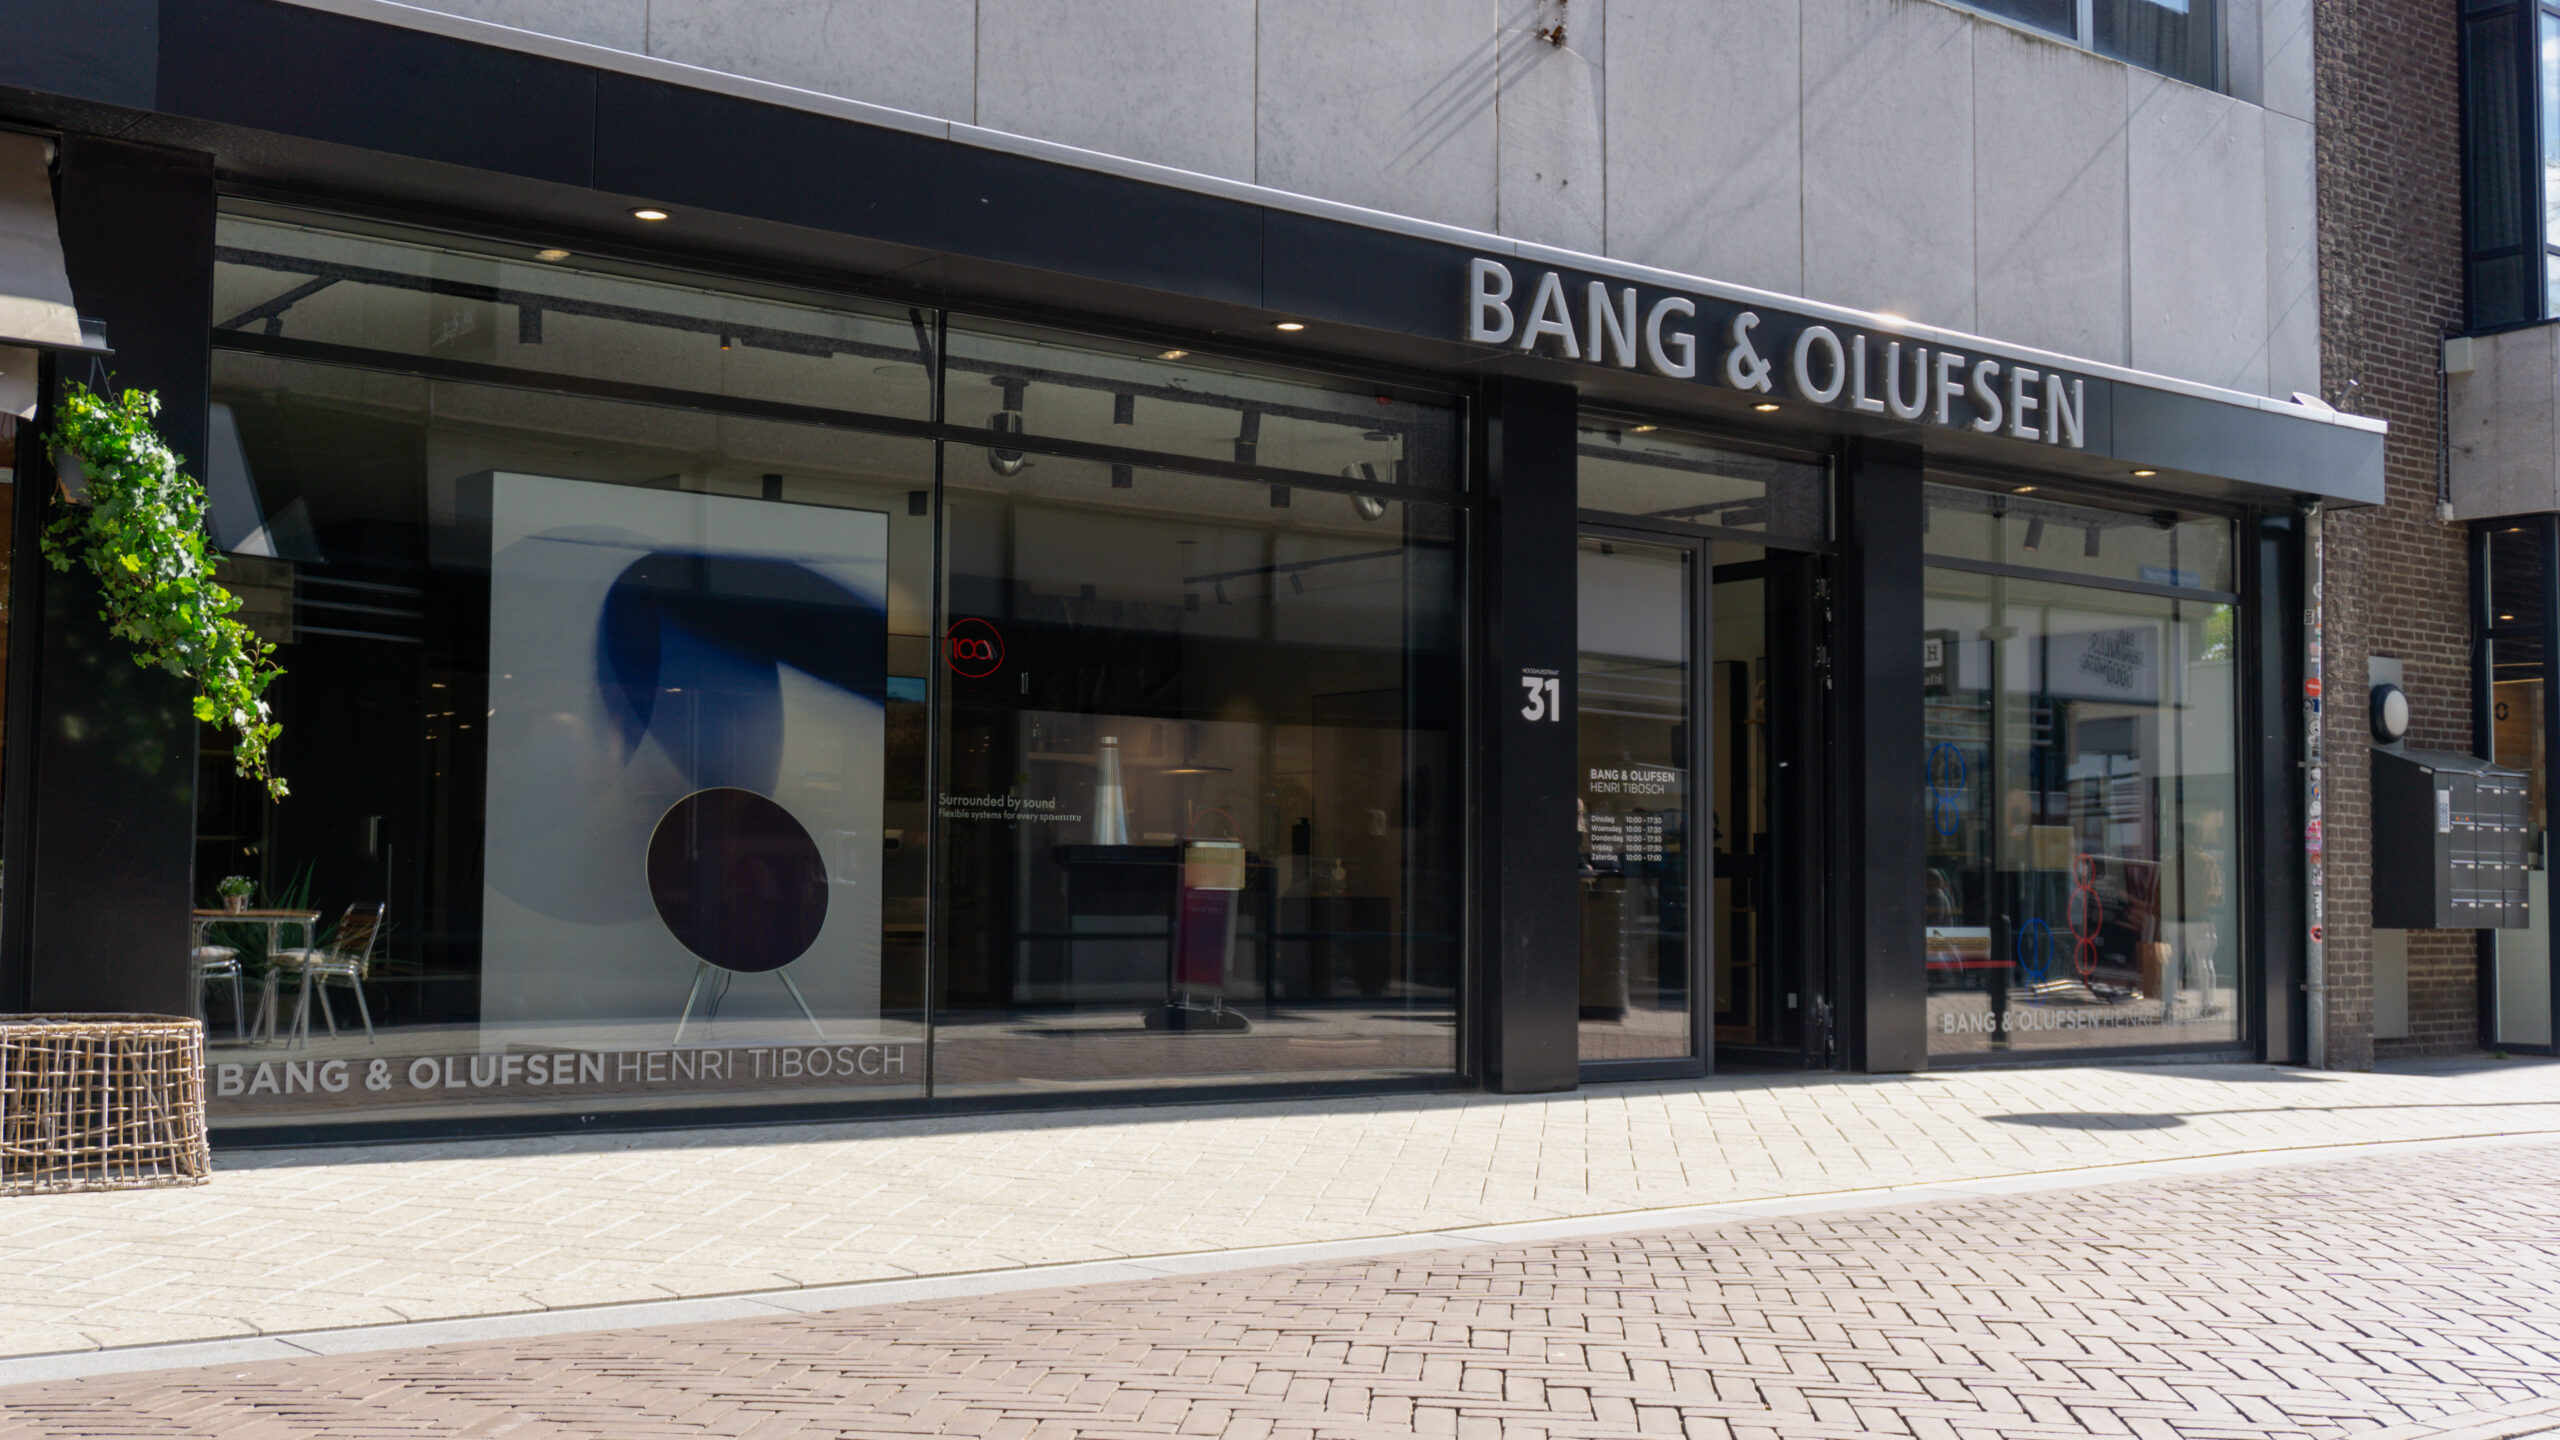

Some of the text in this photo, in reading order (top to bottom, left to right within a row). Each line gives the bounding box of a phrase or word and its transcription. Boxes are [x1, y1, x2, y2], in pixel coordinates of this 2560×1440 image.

[1470, 257, 2084, 449] BANG & OLUFSEN
[1521, 676, 1560, 722] 31
[1590, 768, 1675, 782] BANG & OLUFSEN
[1590, 782, 1664, 794] HENRI TIBOSCH
[939, 792, 1056, 810] Surrounded by sound
[938, 808, 969, 818] Flexible
[971, 811, 1002, 821] systems
[1003, 810, 1015, 819] for
[1016, 814, 1038, 823] every
[1591, 815, 1615, 823] Dinsdag
[1591, 825, 1622, 833] Woensdag
[1591, 835, 1623, 843] Donderdag
[1591, 844, 1613, 852] Vrijdag
[1591, 854, 1618, 862] Zaterdag
[1943, 1012, 1996, 1034] BANG
[2001, 1011, 2013, 1031] &
[2019, 1009, 2098, 1031] OLUFSEN
[217, 1045, 904, 1096] BANG & OLUFSEN HENRI TIBOSCH
